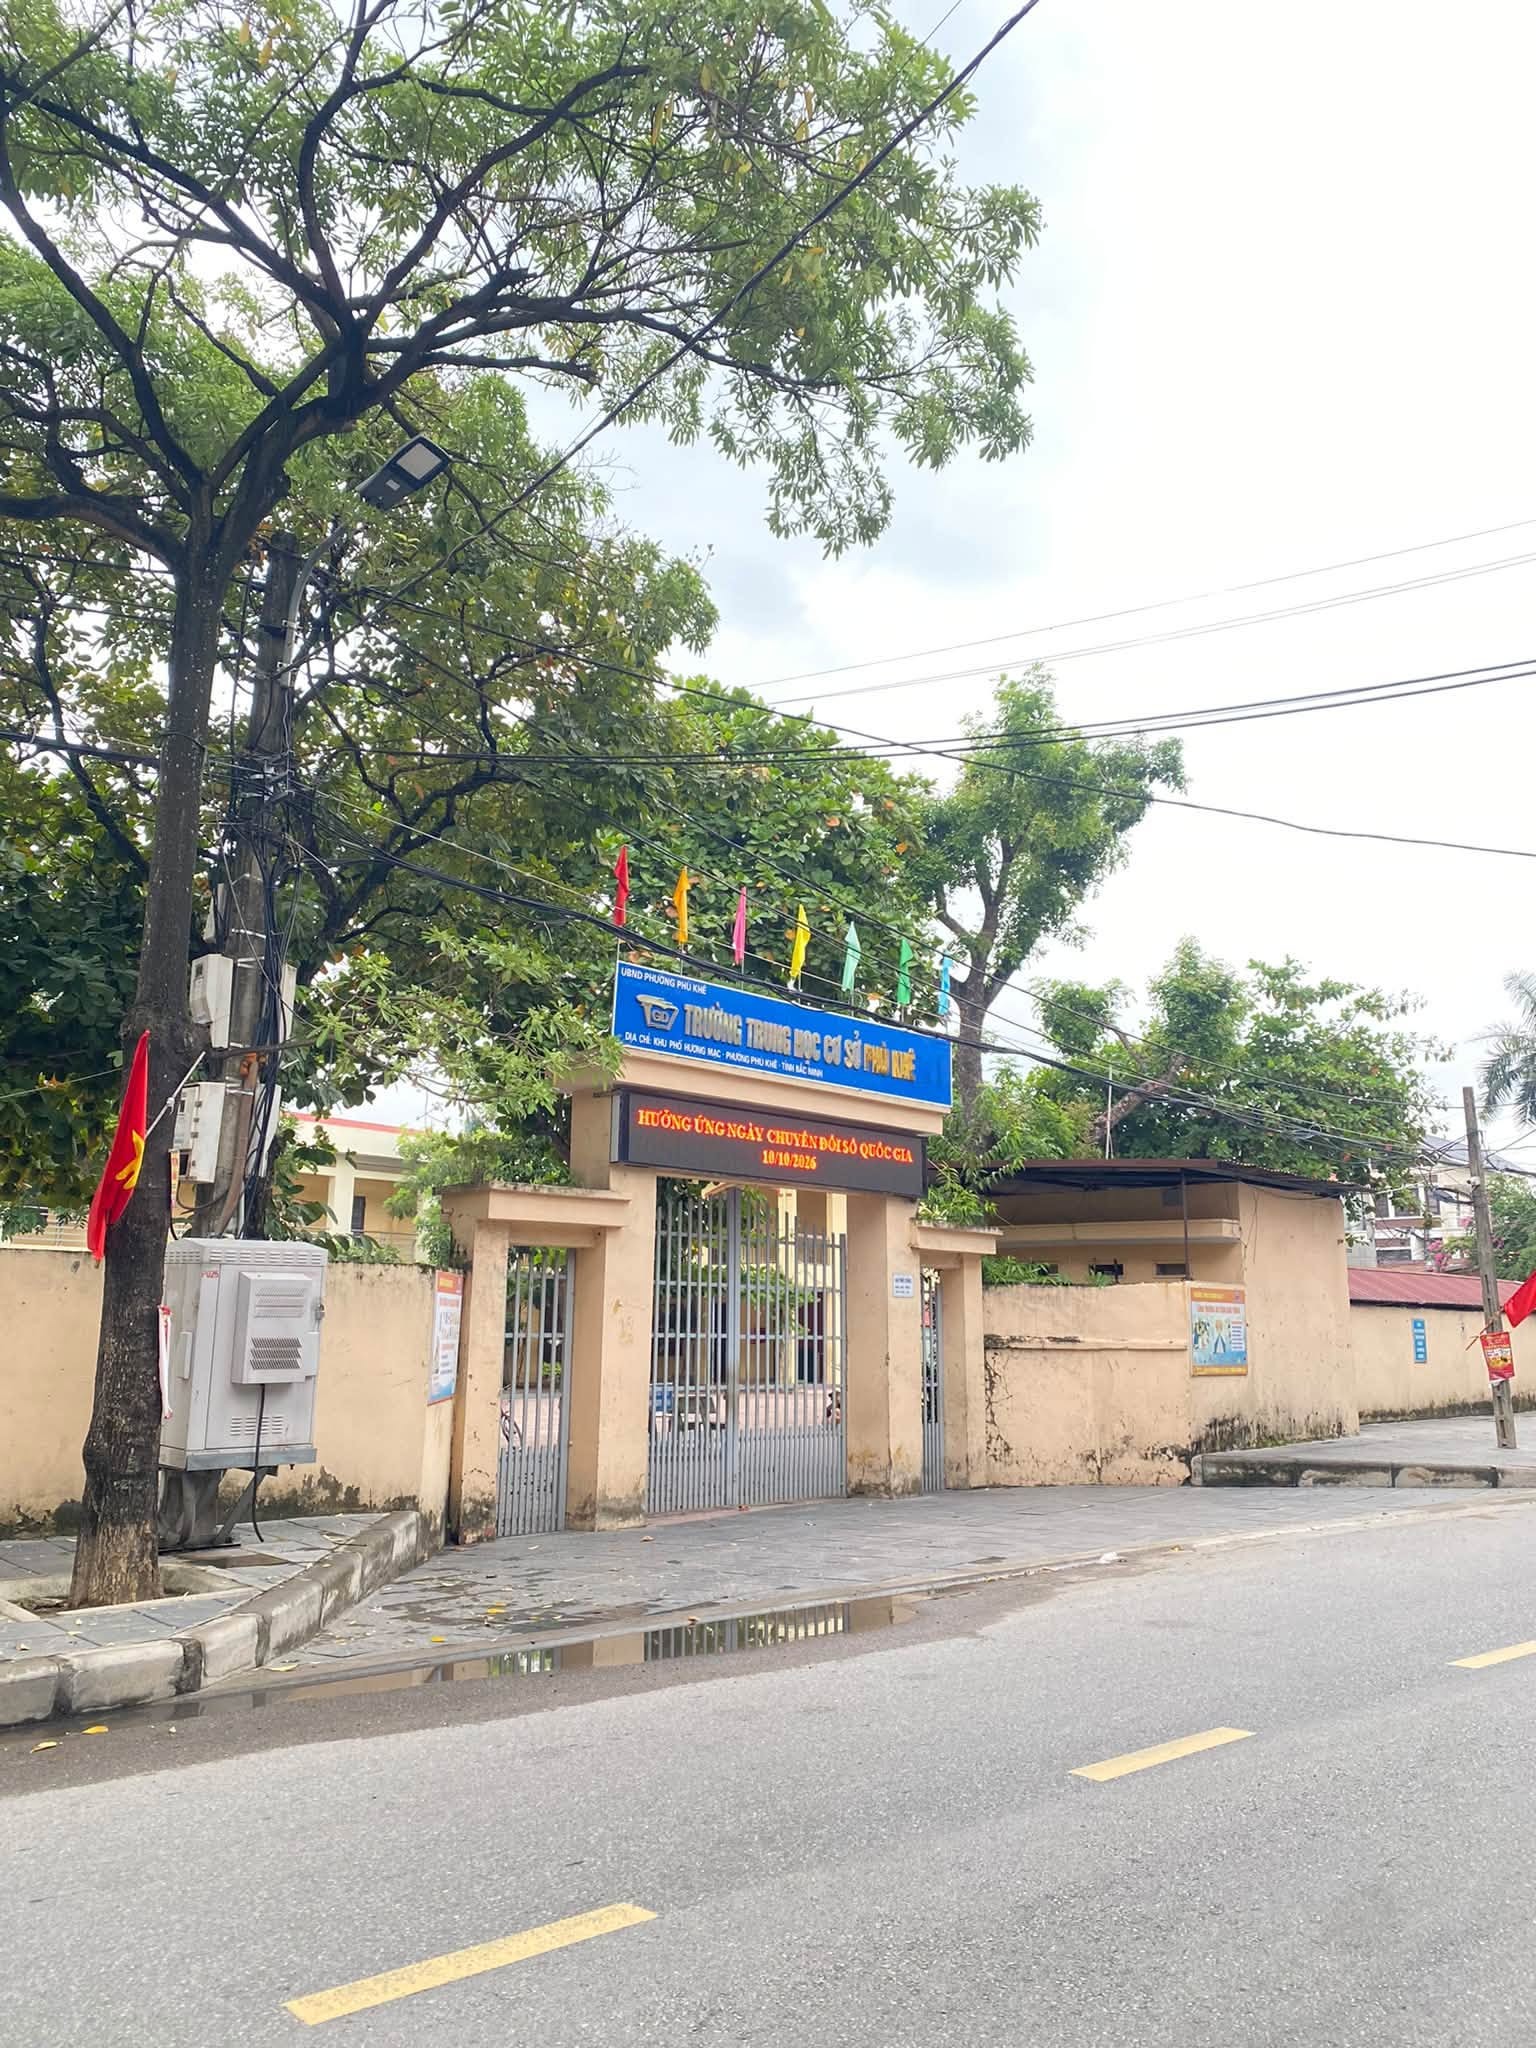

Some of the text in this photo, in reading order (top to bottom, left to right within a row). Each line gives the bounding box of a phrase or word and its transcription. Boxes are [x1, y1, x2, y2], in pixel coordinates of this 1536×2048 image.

[621, 967, 643, 980] UBND
[683, 1001, 743, 1047] TRƯỜNG
[745, 1017, 792, 1056] TRUNG
[793, 1028, 821, 1064] HỌC
[823, 1034, 842, 1066] CƠ
[844, 1030, 862, 1070] SỞ
[653, 1037, 667, 1048] KHU
[807, 1067, 823, 1078] NINH
[694, 1114, 726, 1137] ỨNG
[726, 1122, 764, 1142] NGÀY
[892, 1147, 913, 1164] GIA
[762, 1149, 817, 1171] 10/10/2026
